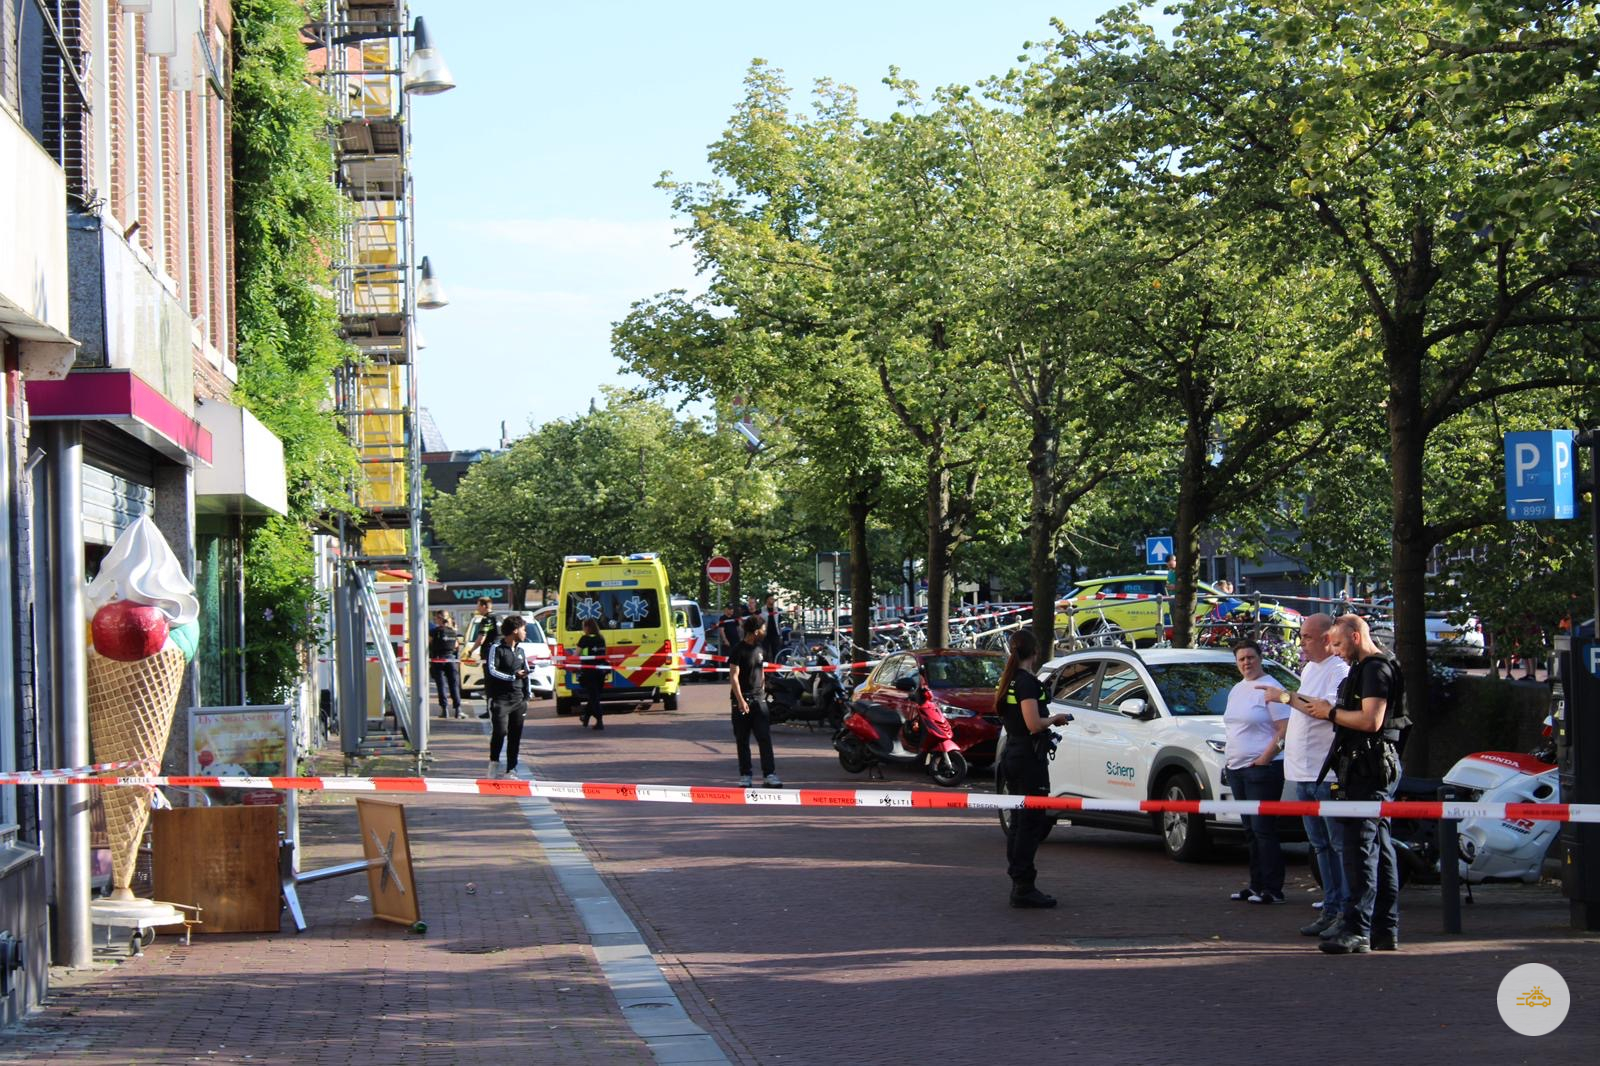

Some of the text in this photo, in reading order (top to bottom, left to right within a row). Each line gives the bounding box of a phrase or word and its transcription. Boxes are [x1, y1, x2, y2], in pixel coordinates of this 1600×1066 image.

[1515, 443, 1540, 487] P
[1556, 441, 1569, 486] P
[1523, 505, 1546, 516] 8997
[1106, 761, 1135, 781] Scherp
[1480, 754, 1520, 768] HONDA
